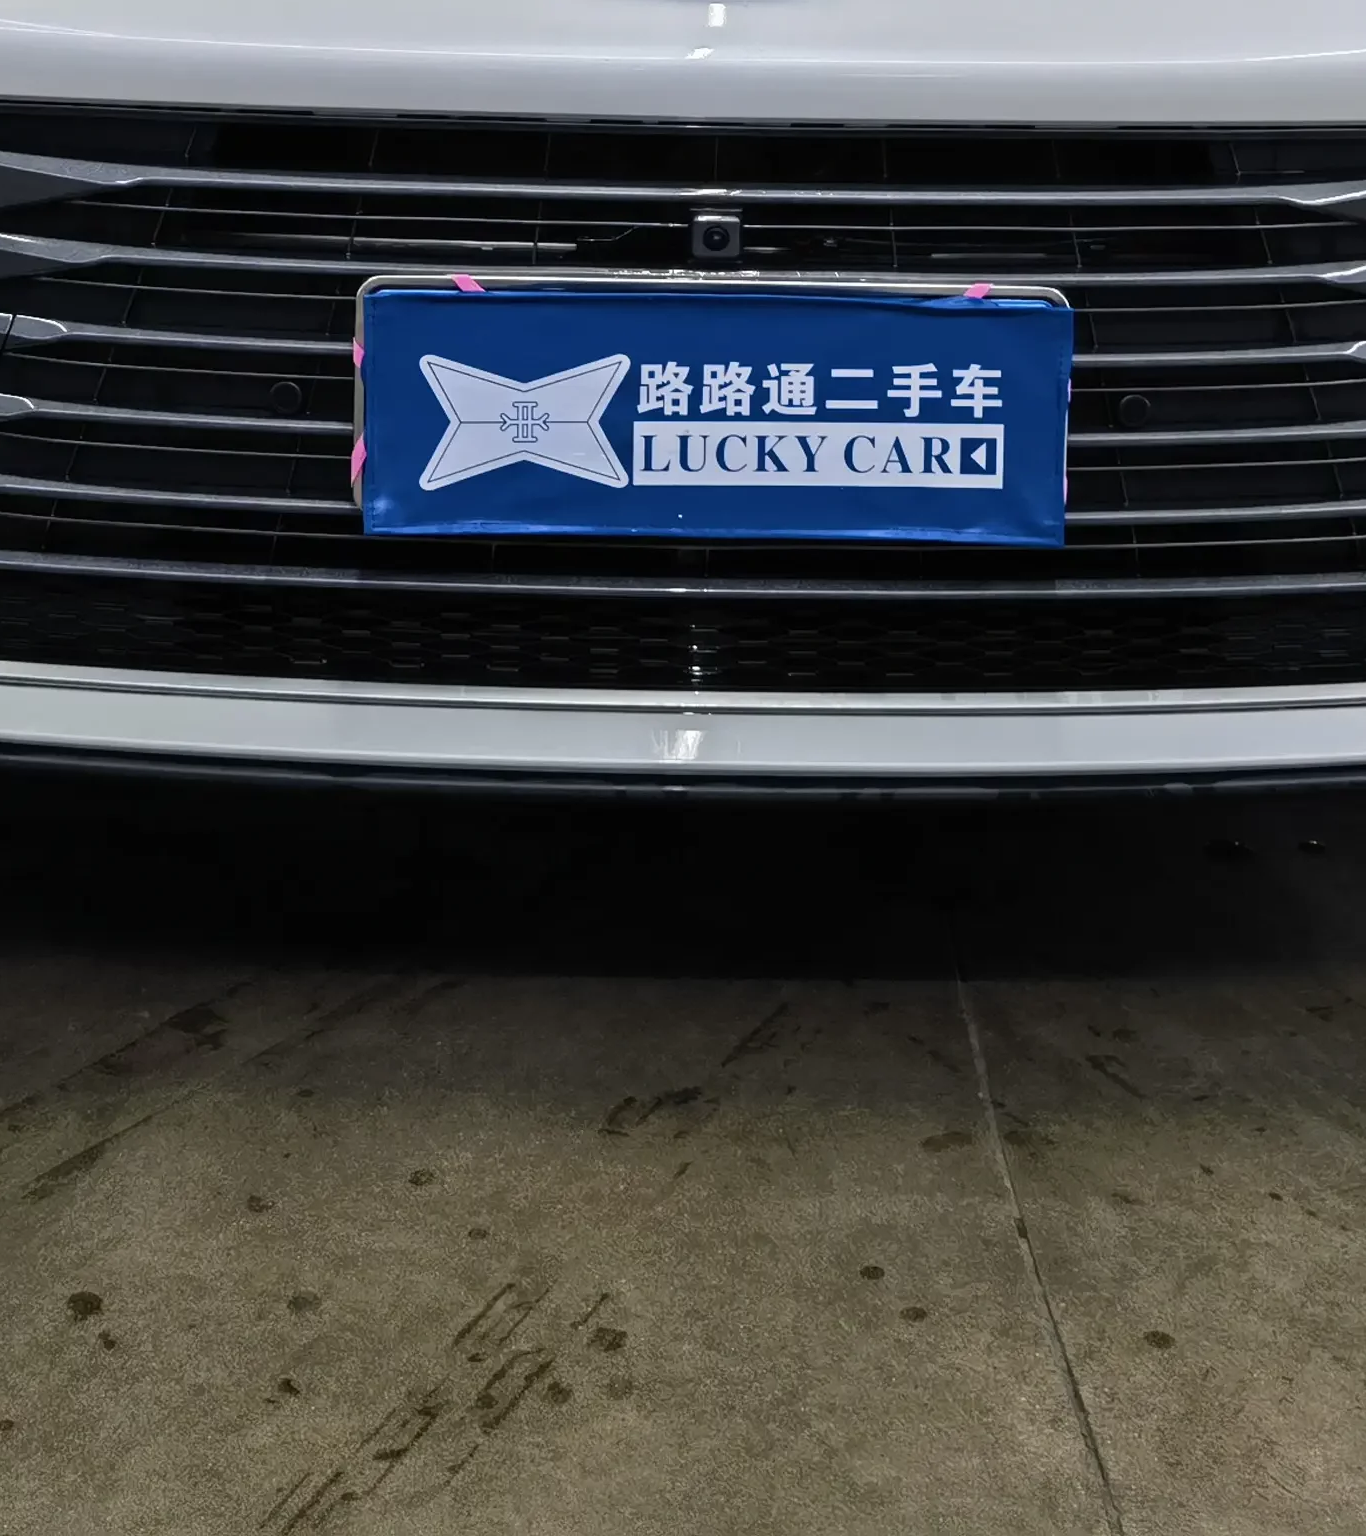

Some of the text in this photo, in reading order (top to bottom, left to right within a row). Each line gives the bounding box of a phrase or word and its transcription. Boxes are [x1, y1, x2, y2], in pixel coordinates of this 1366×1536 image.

[637, 361, 1003, 418] 路路通二手车
[639, 434, 954, 475] LUCKY CAR
